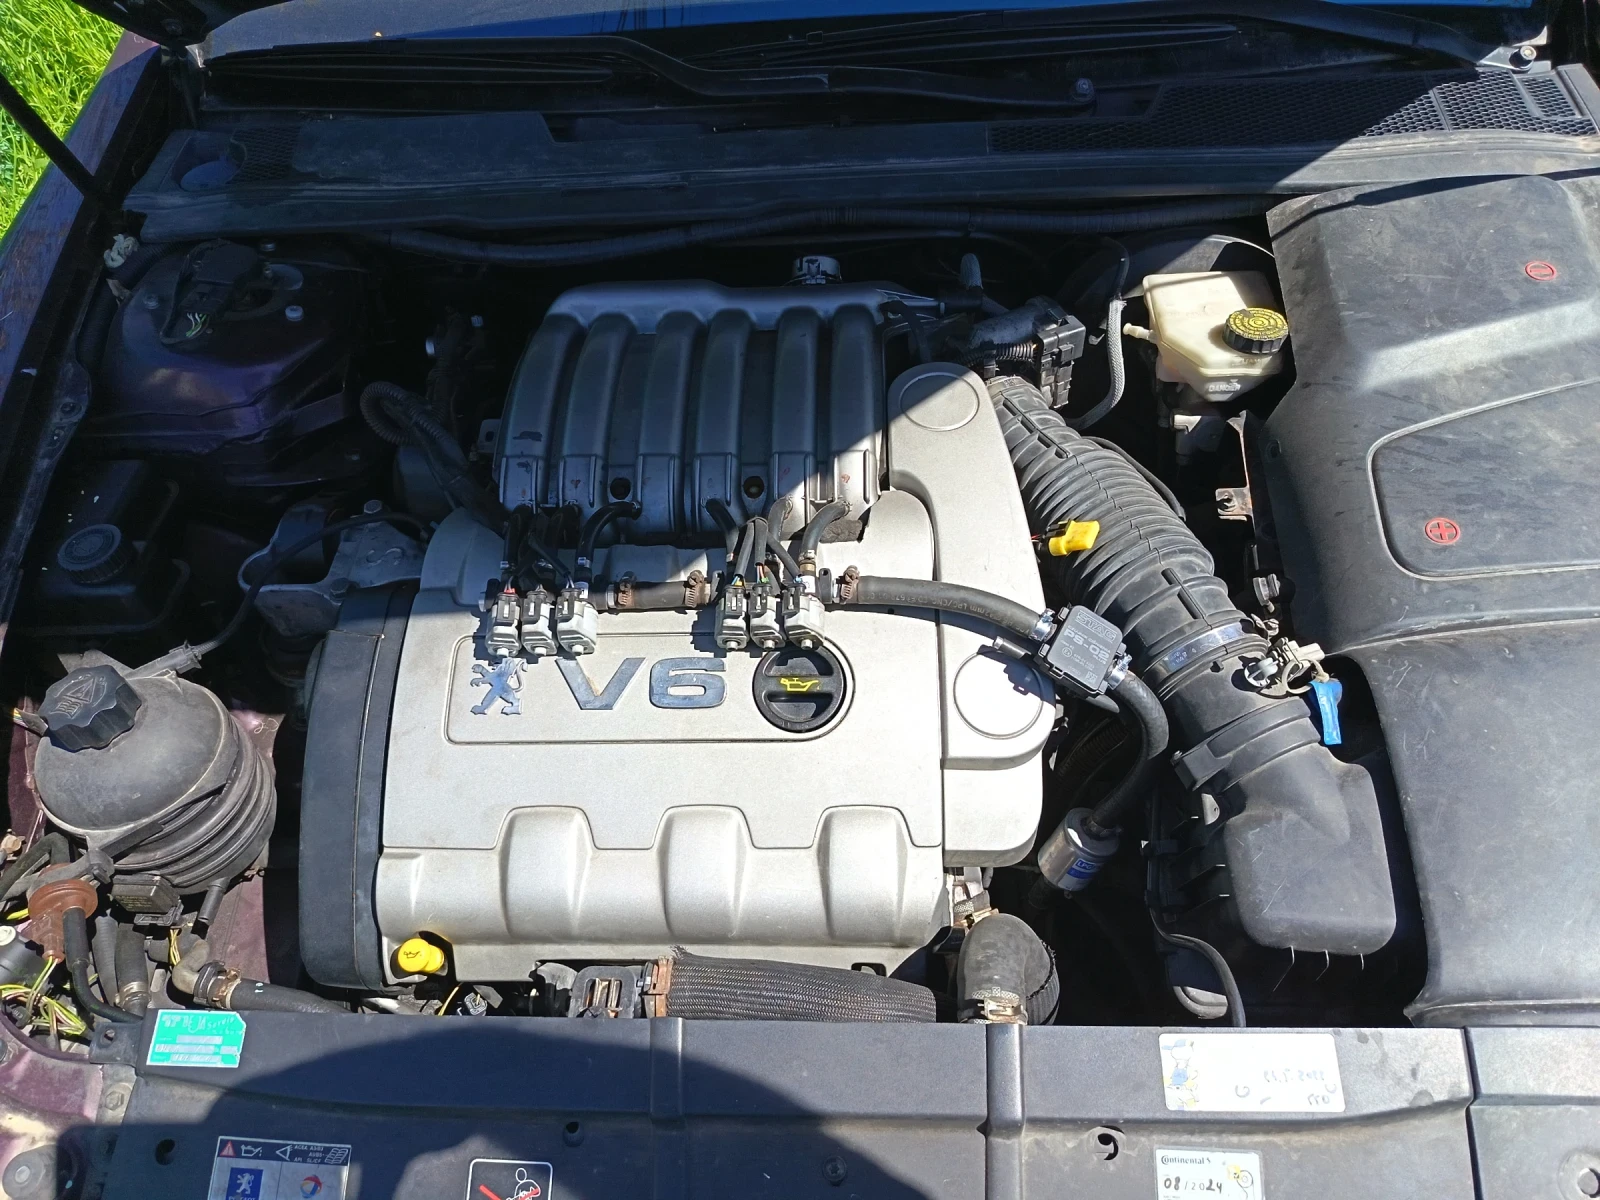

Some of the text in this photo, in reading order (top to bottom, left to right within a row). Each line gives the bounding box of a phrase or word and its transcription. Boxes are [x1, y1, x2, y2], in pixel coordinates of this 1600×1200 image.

[1075, 612, 1117, 641] STAG
[1064, 629, 1110, 659] PS-02
[555, 657, 727, 711] V6
[1161, 1154, 1205, 1166] Continental
